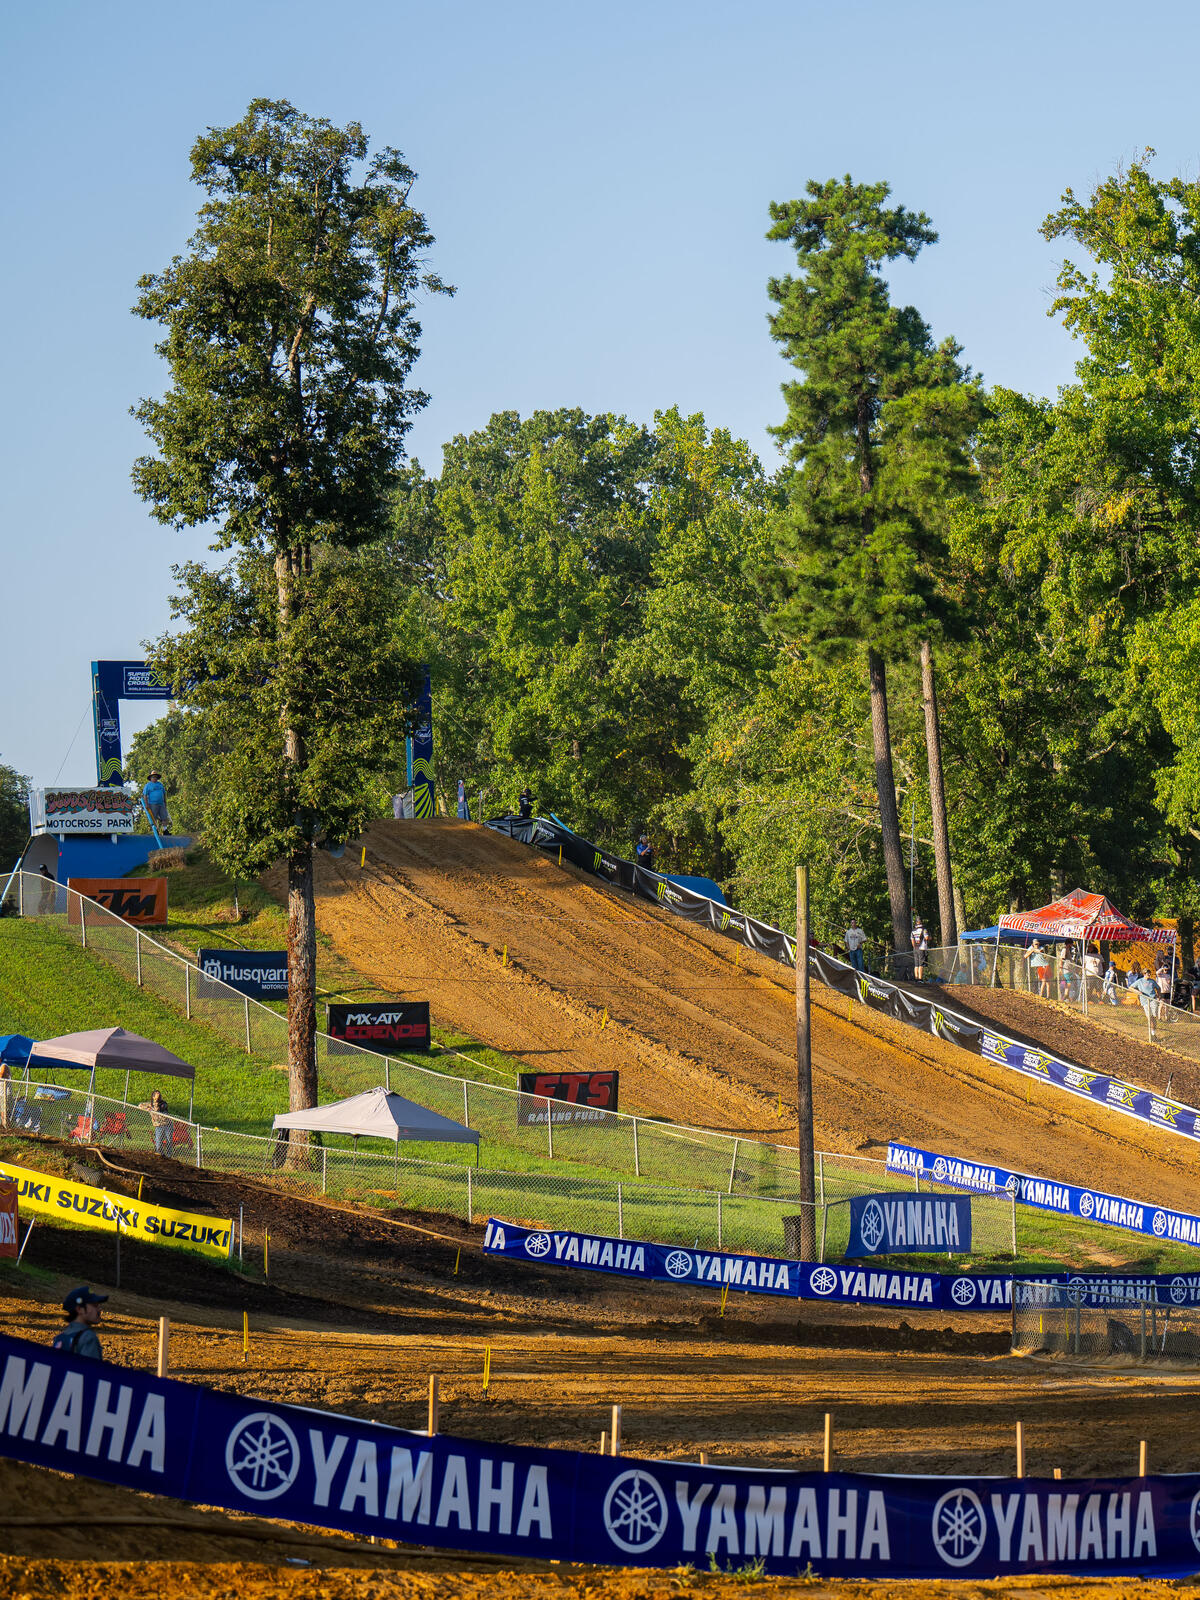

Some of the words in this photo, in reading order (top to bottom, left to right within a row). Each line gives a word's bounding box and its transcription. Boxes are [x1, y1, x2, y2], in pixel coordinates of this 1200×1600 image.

[46, 819, 102, 828] MOTOCROSS
[107, 819, 132, 828] PARK
[82, 889, 157, 916] KTM
[331, 1023, 428, 1041] LEGENDS
[345, 1012, 371, 1026] MX
[374, 1012, 404, 1025] ATV
[533, 1072, 613, 1108] ETS
[528, 1112, 572, 1122] RACING
[574, 1111, 606, 1121] FUELS
[948, 1160, 996, 1192] YAMAHA
[56, 1190, 139, 1229] SUZUKI
[1020, 1179, 1070, 1211] YAMAHA
[883, 1201, 959, 1247] YAMAHA
[1093, 1196, 1143, 1229] YAMAHA
[144, 1215, 230, 1248] SUZUKI
[553, 1234, 645, 1272] YAMAHA
[694, 1254, 789, 1290] YAMAHA
[840, 1270, 933, 1303] YAMAHA
[978, 1279, 1061, 1304] YAMAHA
[1089, 1278, 1159, 1303] YAMAHA
[308, 1428, 553, 1540] YAMAHA
[676, 1481, 891, 1561] YAMAHA
[991, 1491, 1157, 1561] YAMAHA
